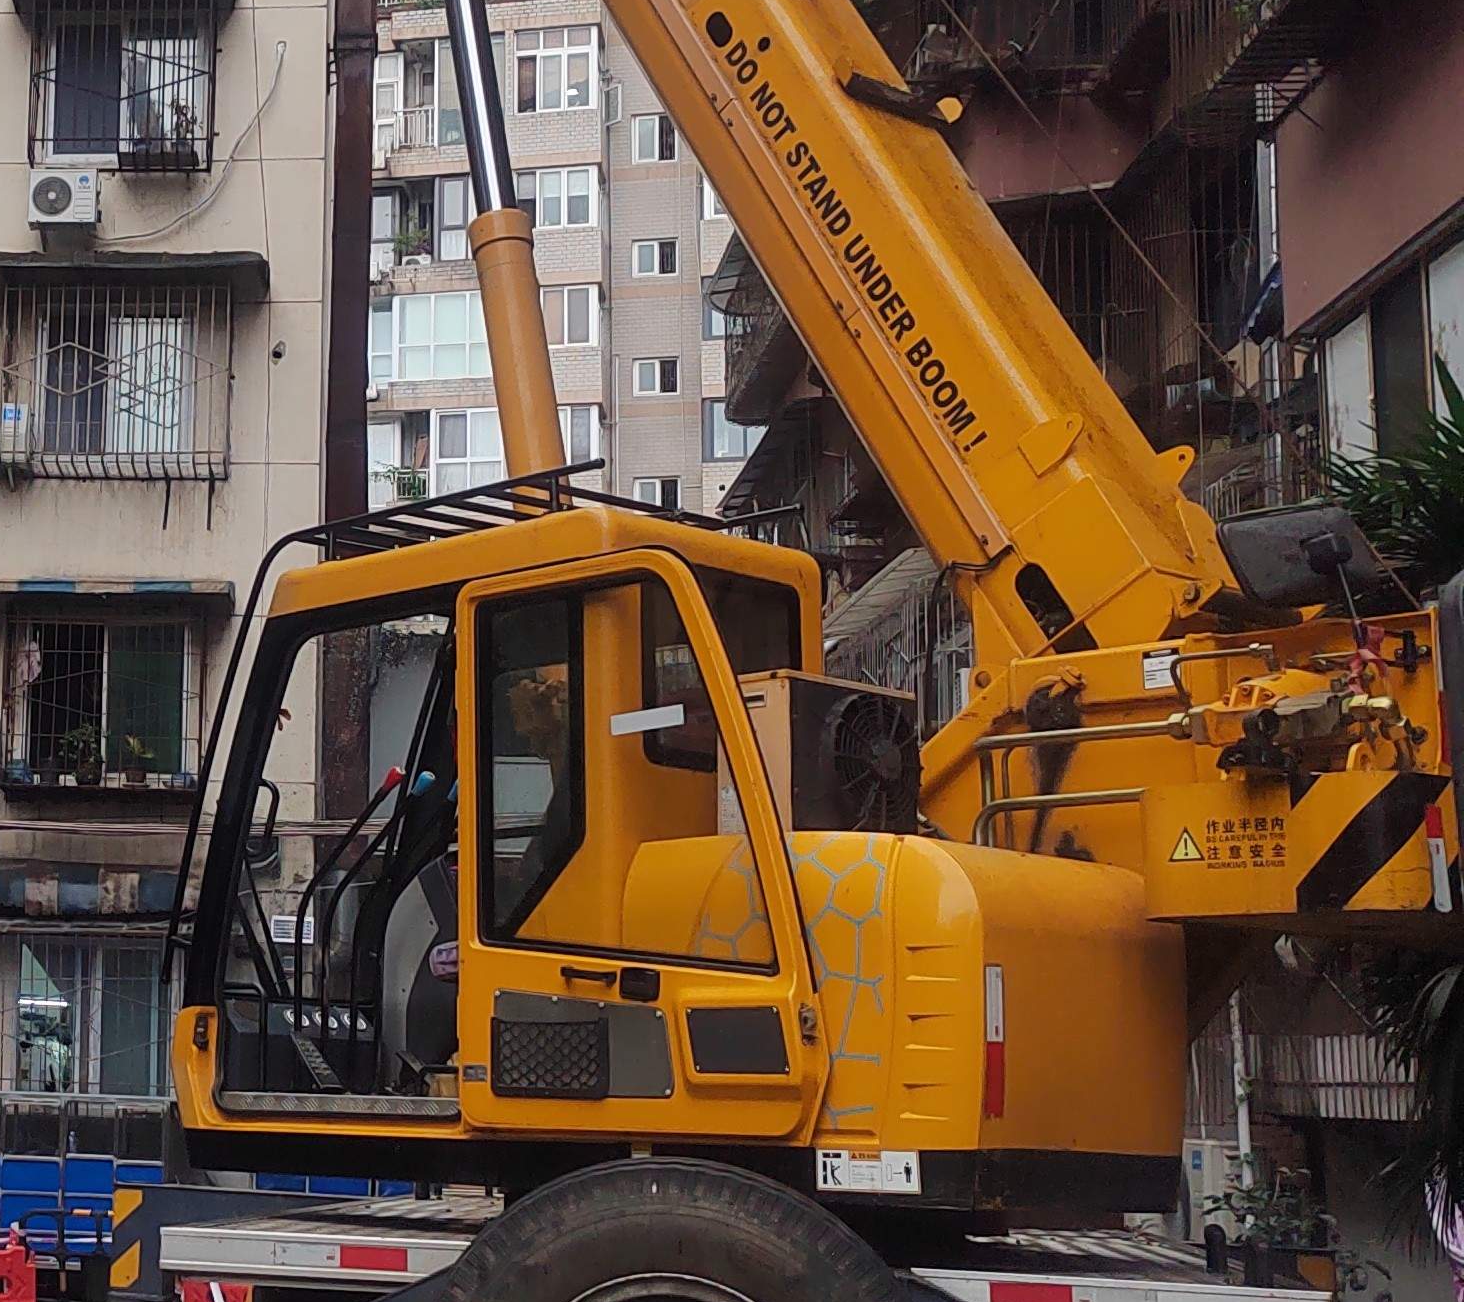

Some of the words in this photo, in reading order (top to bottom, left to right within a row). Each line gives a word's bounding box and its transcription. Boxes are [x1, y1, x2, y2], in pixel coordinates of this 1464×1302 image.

[725, 42, 757, 84] DO
[749, 81, 796, 142] NOT
[786, 140, 851, 237] STAND
[844, 233, 916, 344] UNDER
[1206, 817, 1286, 834] 作业半径内
[1206, 843, 1287, 860] 注意安全
